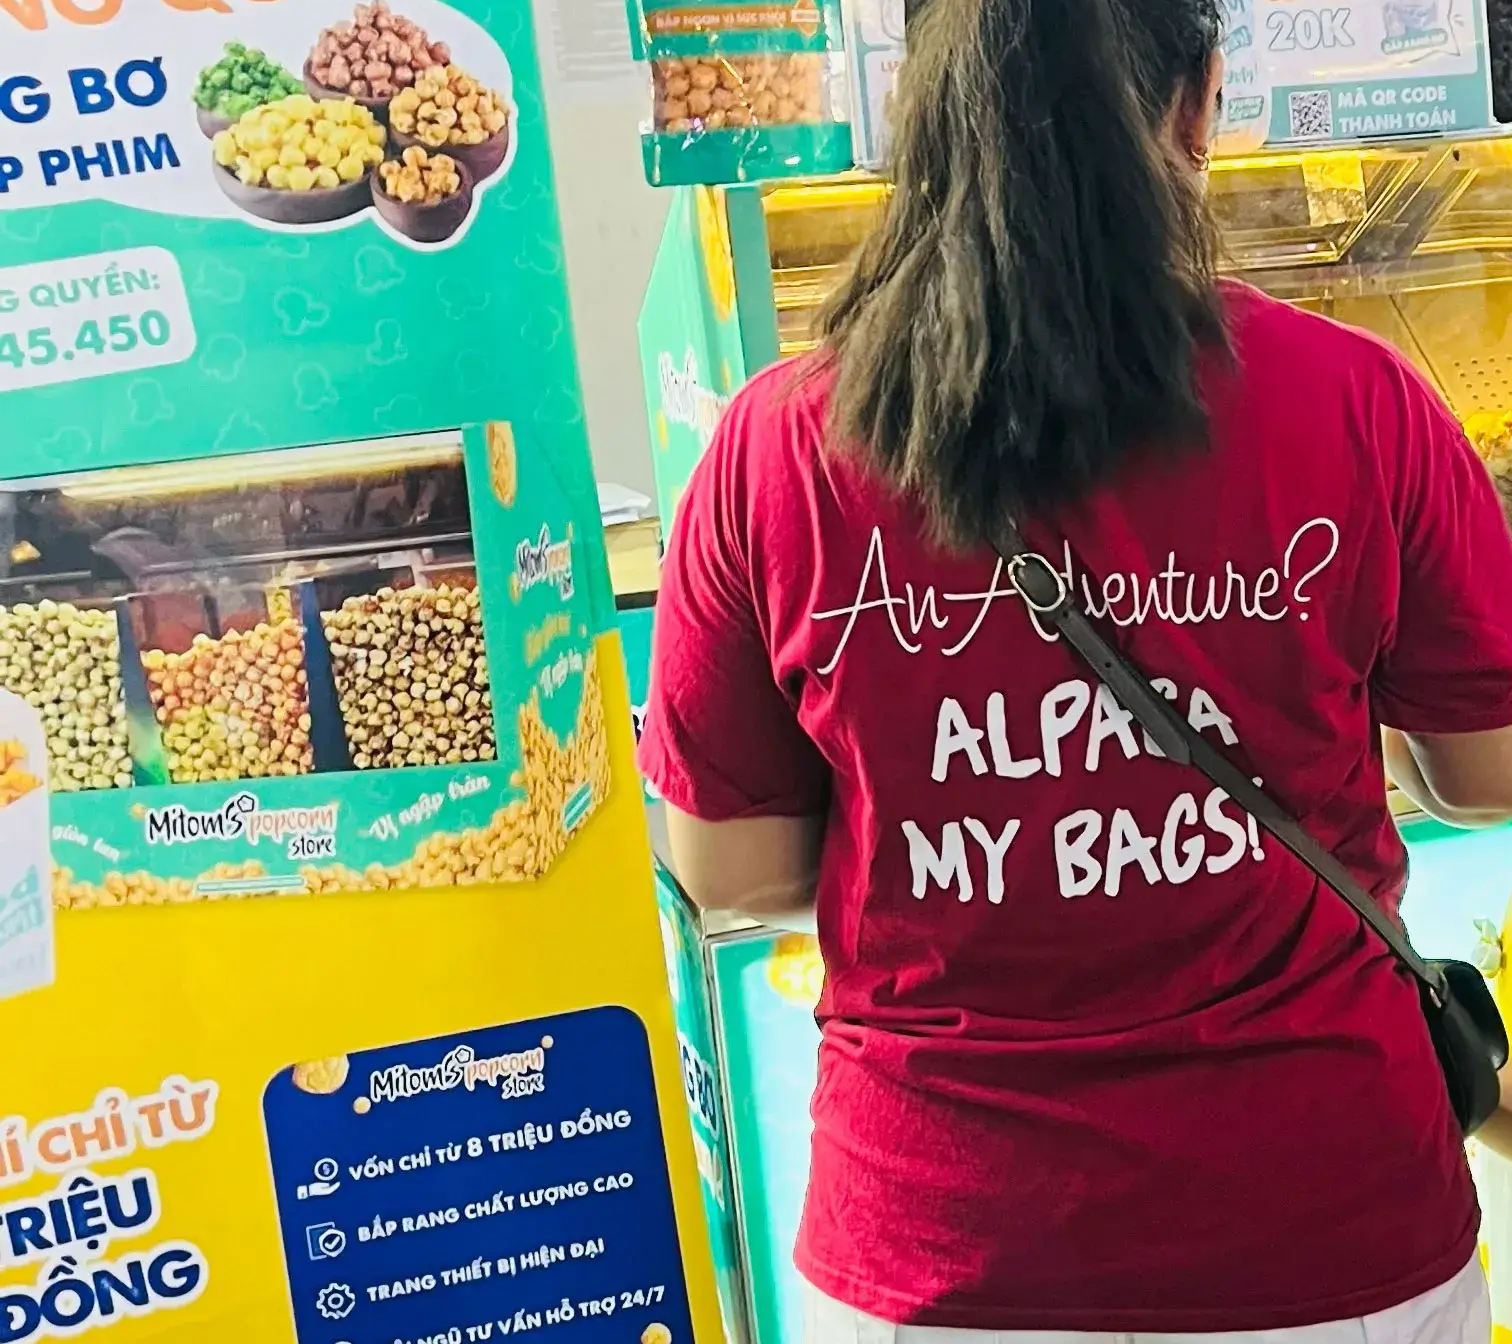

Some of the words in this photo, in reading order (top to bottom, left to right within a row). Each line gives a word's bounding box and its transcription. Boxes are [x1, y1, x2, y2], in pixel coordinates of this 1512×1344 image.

[1266, 7, 1355, 52] 20K
[68, 56, 167, 114] BƠ
[1338, 87, 1368, 109] MÃ
[1371, 90, 1397, 106] QR
[1401, 85, 1447, 104] CODE
[1338, 115, 1402, 134] THANH
[1406, 108, 1456, 128] TOÁN
[38, 133, 181, 186] PHIM
[942, 517, 1340, 656] Aventure?
[149, 798, 243, 840] Mitom's
[250, 807, 334, 842] popcorn
[291, 834, 333, 856] store
[901, 816, 1021, 904] MY
[467, 1047, 543, 1090] popcorn
[503, 1073, 544, 1099] store
[38, 1097, 127, 1164] CHỈ
[139, 1084, 210, 1138] TỪ
[349, 1154, 393, 1181] VỐN
[399, 1145, 432, 1171] CHỈ
[435, 1140, 462, 1164] TỪ
[467, 1137, 482, 1158] 8
[488, 1122, 552, 1153] TRIỆU
[560, 1107, 631, 1139] ĐỒNG
[0, 1177, 152, 1256] RIỆU
[358, 1214, 397, 1242] BẮP
[402, 1207, 460, 1233] RANG
[465, 1190, 515, 1219] CHẤT
[520, 1181, 589, 1208] LƯỢNG
[593, 1172, 634, 1193] CAO
[367, 1274, 436, 1302] TRANG
[441, 1256, 492, 1286] THIẾT
[497, 1257, 517, 1278] BỊ
[520, 1244, 566, 1270] HIỆN
[570, 1237, 605, 1259] ĐẠI
[466, 1321, 493, 1341] TƯ
[498, 1307, 541, 1336] VẤN
[546, 1297, 575, 1324] HỖ
[578, 1295, 616, 1317] TRỢ
[620, 1285, 665, 1309] 24/7
